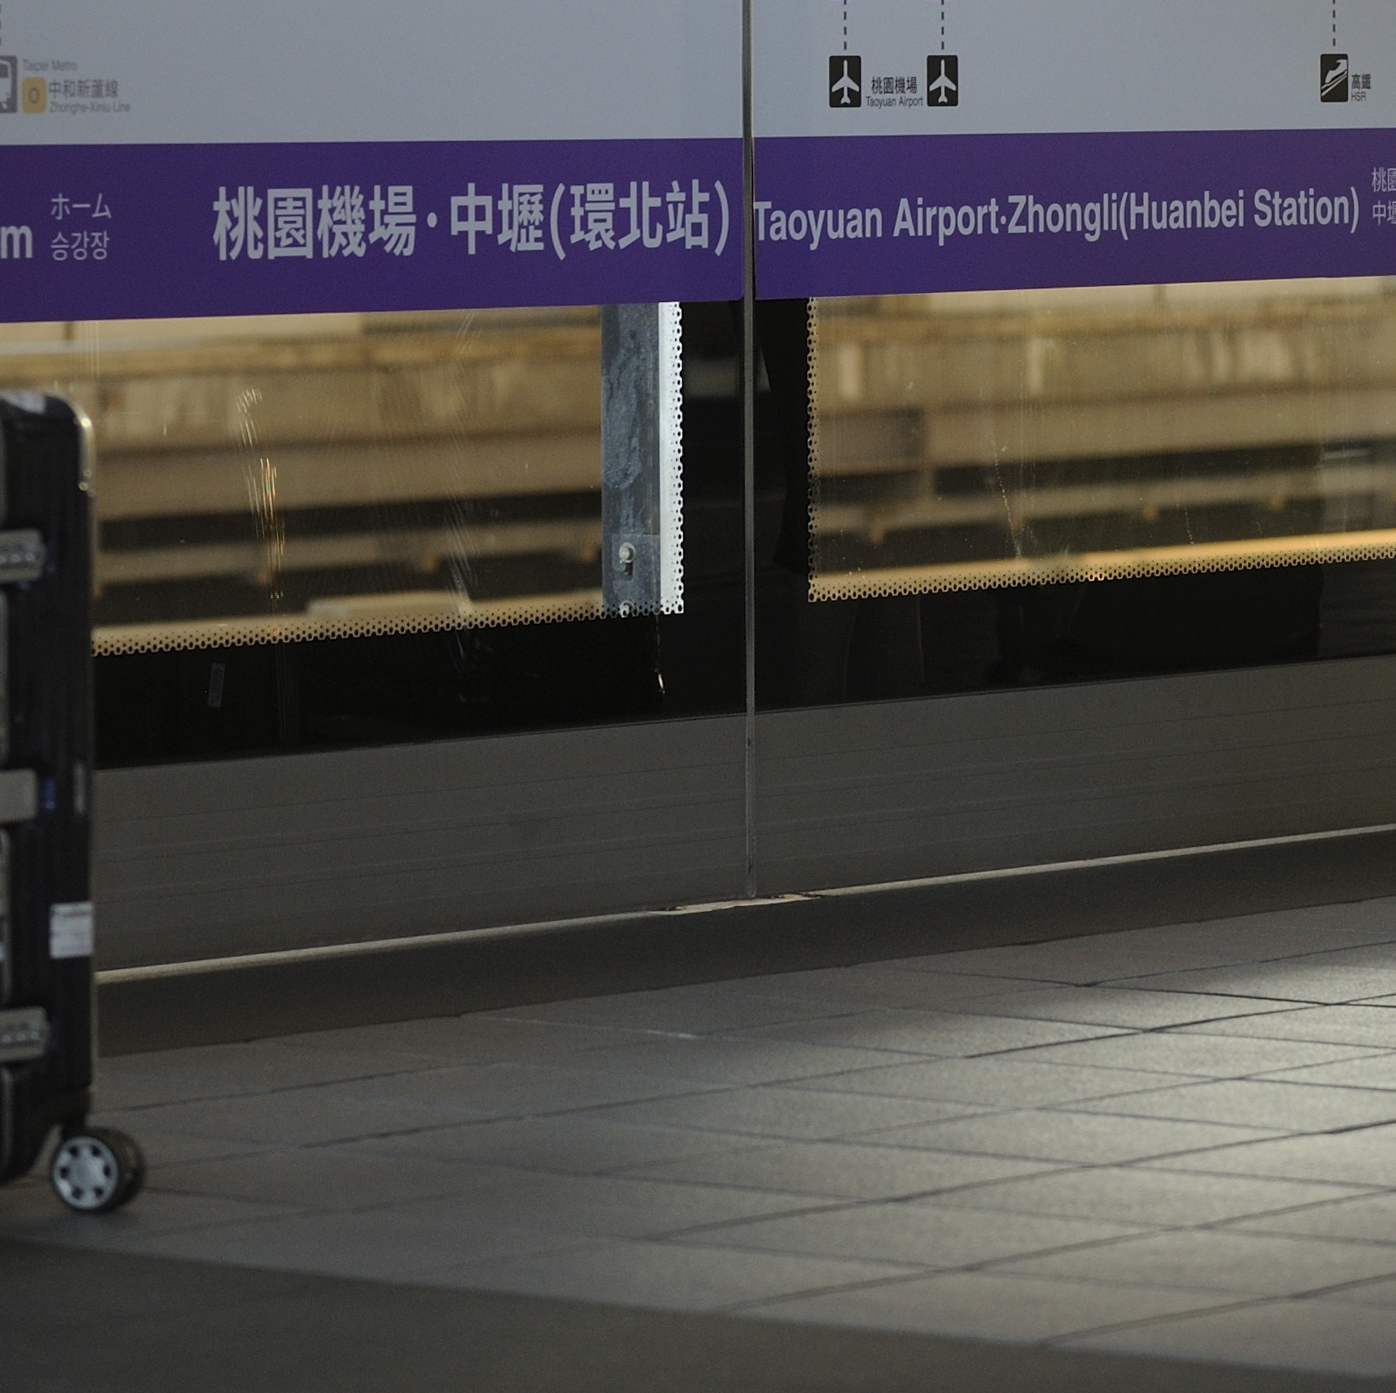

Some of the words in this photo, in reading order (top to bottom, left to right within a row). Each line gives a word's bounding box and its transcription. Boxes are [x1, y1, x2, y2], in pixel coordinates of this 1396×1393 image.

[871, 76, 917, 94] 桃園機場
[866, 96, 896, 109] Taoyuan
[899, 96, 923, 109] Airport
[50, 193, 112, 220] ホーム
[754, 201, 883, 251] Taoyuan
[1253, 187, 1360, 234] Station)
[50, 230, 110, 261] 승강장
